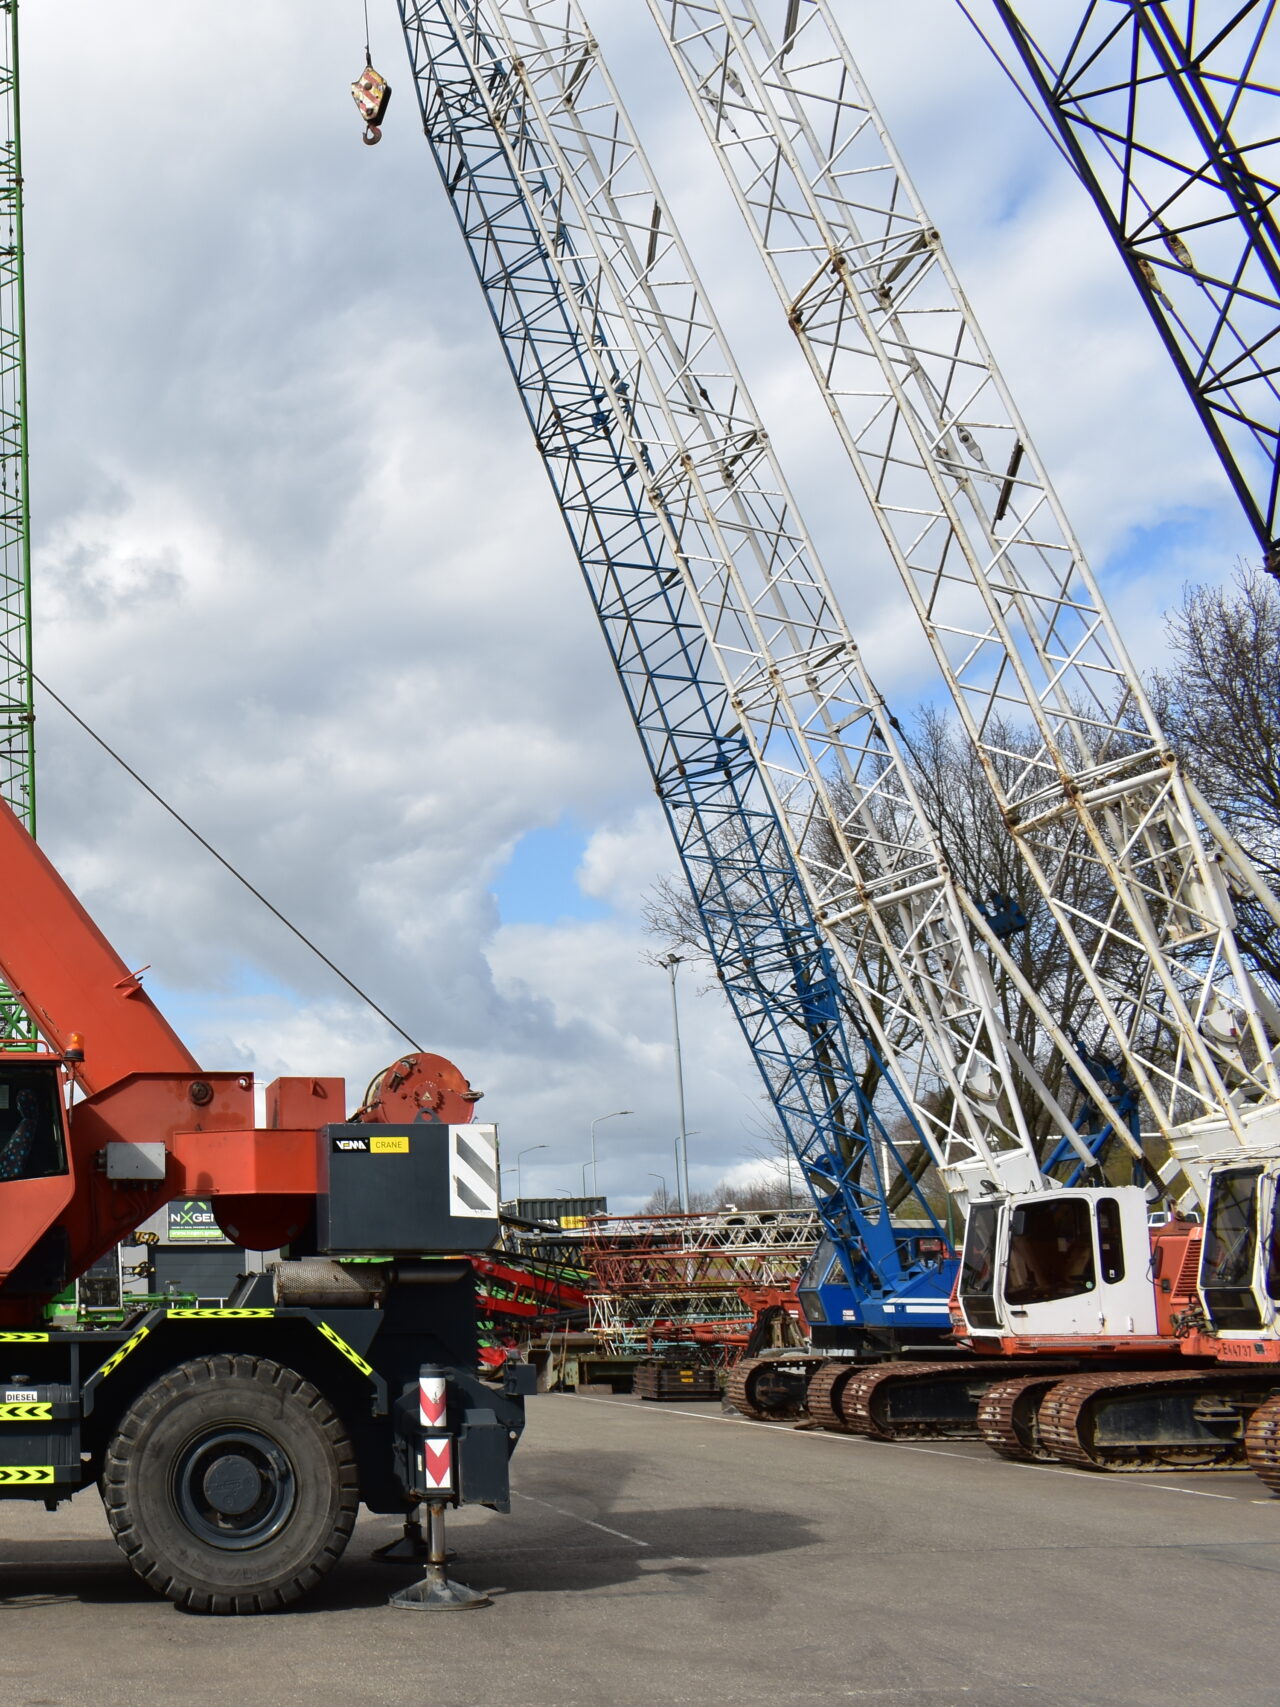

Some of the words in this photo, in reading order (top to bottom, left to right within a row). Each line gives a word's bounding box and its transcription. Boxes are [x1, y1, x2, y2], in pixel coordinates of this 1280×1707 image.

[336, 1140, 367, 1150] VEMA
[375, 1141, 403, 1149] CRANE
[6, 1393, 37, 1401] DIESEL
